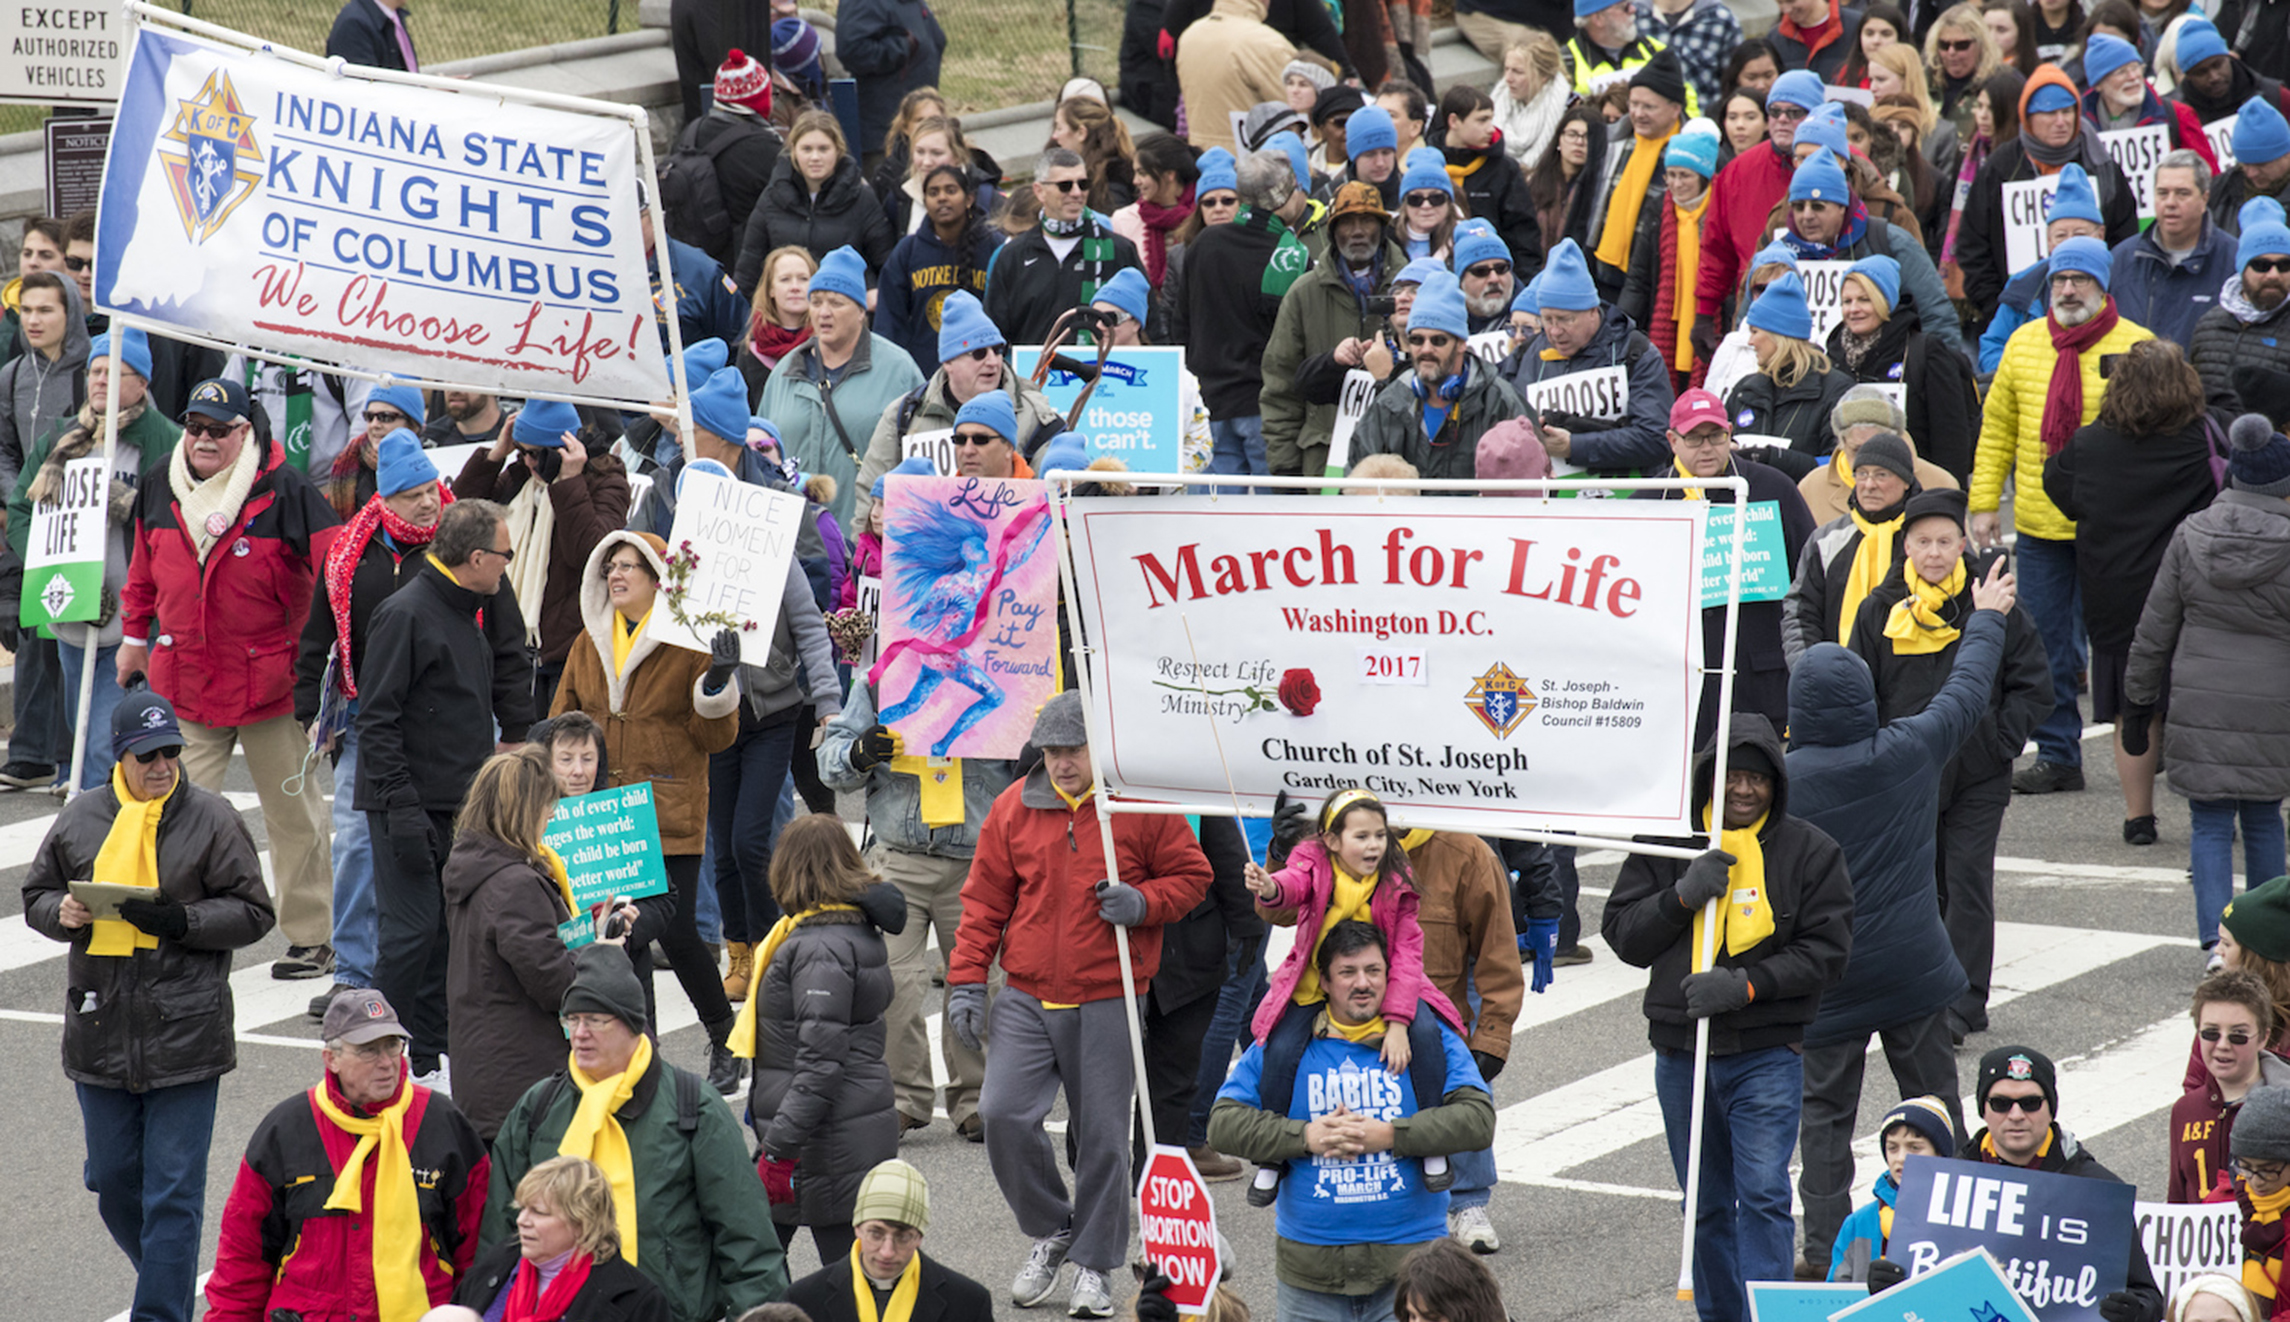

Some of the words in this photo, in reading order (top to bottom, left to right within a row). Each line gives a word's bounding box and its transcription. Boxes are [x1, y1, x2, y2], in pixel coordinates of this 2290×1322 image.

[21, 7, 108, 31] EXCEPT
[12, 36, 119, 60] AUTHORIZED
[25, 65, 106, 89] VEHICLES
[274, 91, 447, 160] INDIANA
[463, 132, 607, 188] STATE
[266, 145, 612, 248] KNIGHTS
[262, 212, 318, 253] OF
[333, 227, 620, 303] COLUMBUS
[911, 265, 952, 292] NOTRE
[252, 261, 319, 316] We
[337, 274, 490, 346] Choose
[504, 300, 644, 385] Life!
[1088, 406, 1154, 428] those
[1094, 429, 1157, 450] can't.
[38, 467, 102, 515] OOSE
[713, 481, 784, 524] NICE
[949, 477, 1027, 519] Life
[45, 512, 78, 556] LIFE
[697, 510, 784, 558] WOMEN
[711, 551, 752, 583] FOR
[1131, 529, 1359, 609] March
[1381, 527, 1484, 589] for
[1500, 537, 1642, 619] Life
[686, 574, 756, 616] LIFE
[997, 588, 1046, 631] Pay
[988, 621, 1027, 648] it
[1281, 606, 1429, 640] Washington
[1437, 610, 1494, 636] D.C.
[983, 650, 1054, 678] Forward
[1157, 655, 1229, 683] Respect
[1236, 659, 1276, 687] Life
[1364, 655, 1421, 679] 2017
[1541, 679, 1559, 692] St.
[1562, 681, 1610, 694] Joseph
[1161, 694, 1245, 724] Ministry
[1541, 697, 1588, 712] Bishop
[1591, 698, 1645, 712] Baldwin
[1541, 714, 1592, 727] Council
[1595, 716, 1641, 729] #15809
[1261, 737, 1358, 764] Church
[1365, 743, 1392, 766] of
[1398, 743, 1431, 768] St.
[1439, 745, 1528, 776] Joseph
[1283, 771, 1359, 790] Garden
[1364, 775, 1414, 797] City,
[1418, 777, 1461, 796] New
[1467, 779, 1518, 799] York
[572, 800, 586, 817] of
[587, 798, 620, 815] every
[621, 788, 649, 808] child
[575, 824, 595, 841] the
[596, 815, 636, 836] world:
[572, 844, 603, 865] child
[605, 842, 620, 858] be
[621, 839, 648, 855] born
[605, 859, 644, 882] world"
[366, 1001, 384, 1018] D
[1308, 1068, 1403, 1112] BABIES
[2181, 1120, 2215, 1143] A&F
[1318, 1163, 1400, 1184] PRO-LIFE
[1336, 1181, 1382, 1196] MARCH
[1150, 1175, 1195, 1211] STOP
[1926, 1172, 2029, 1237] LIFE
[2040, 1215, 2089, 1245] IS
[2138, 1213, 2236, 1268] CHOOSE
[1150, 1251, 1206, 1288] NOW
[1908, 1240, 2098, 1308] Btiful
